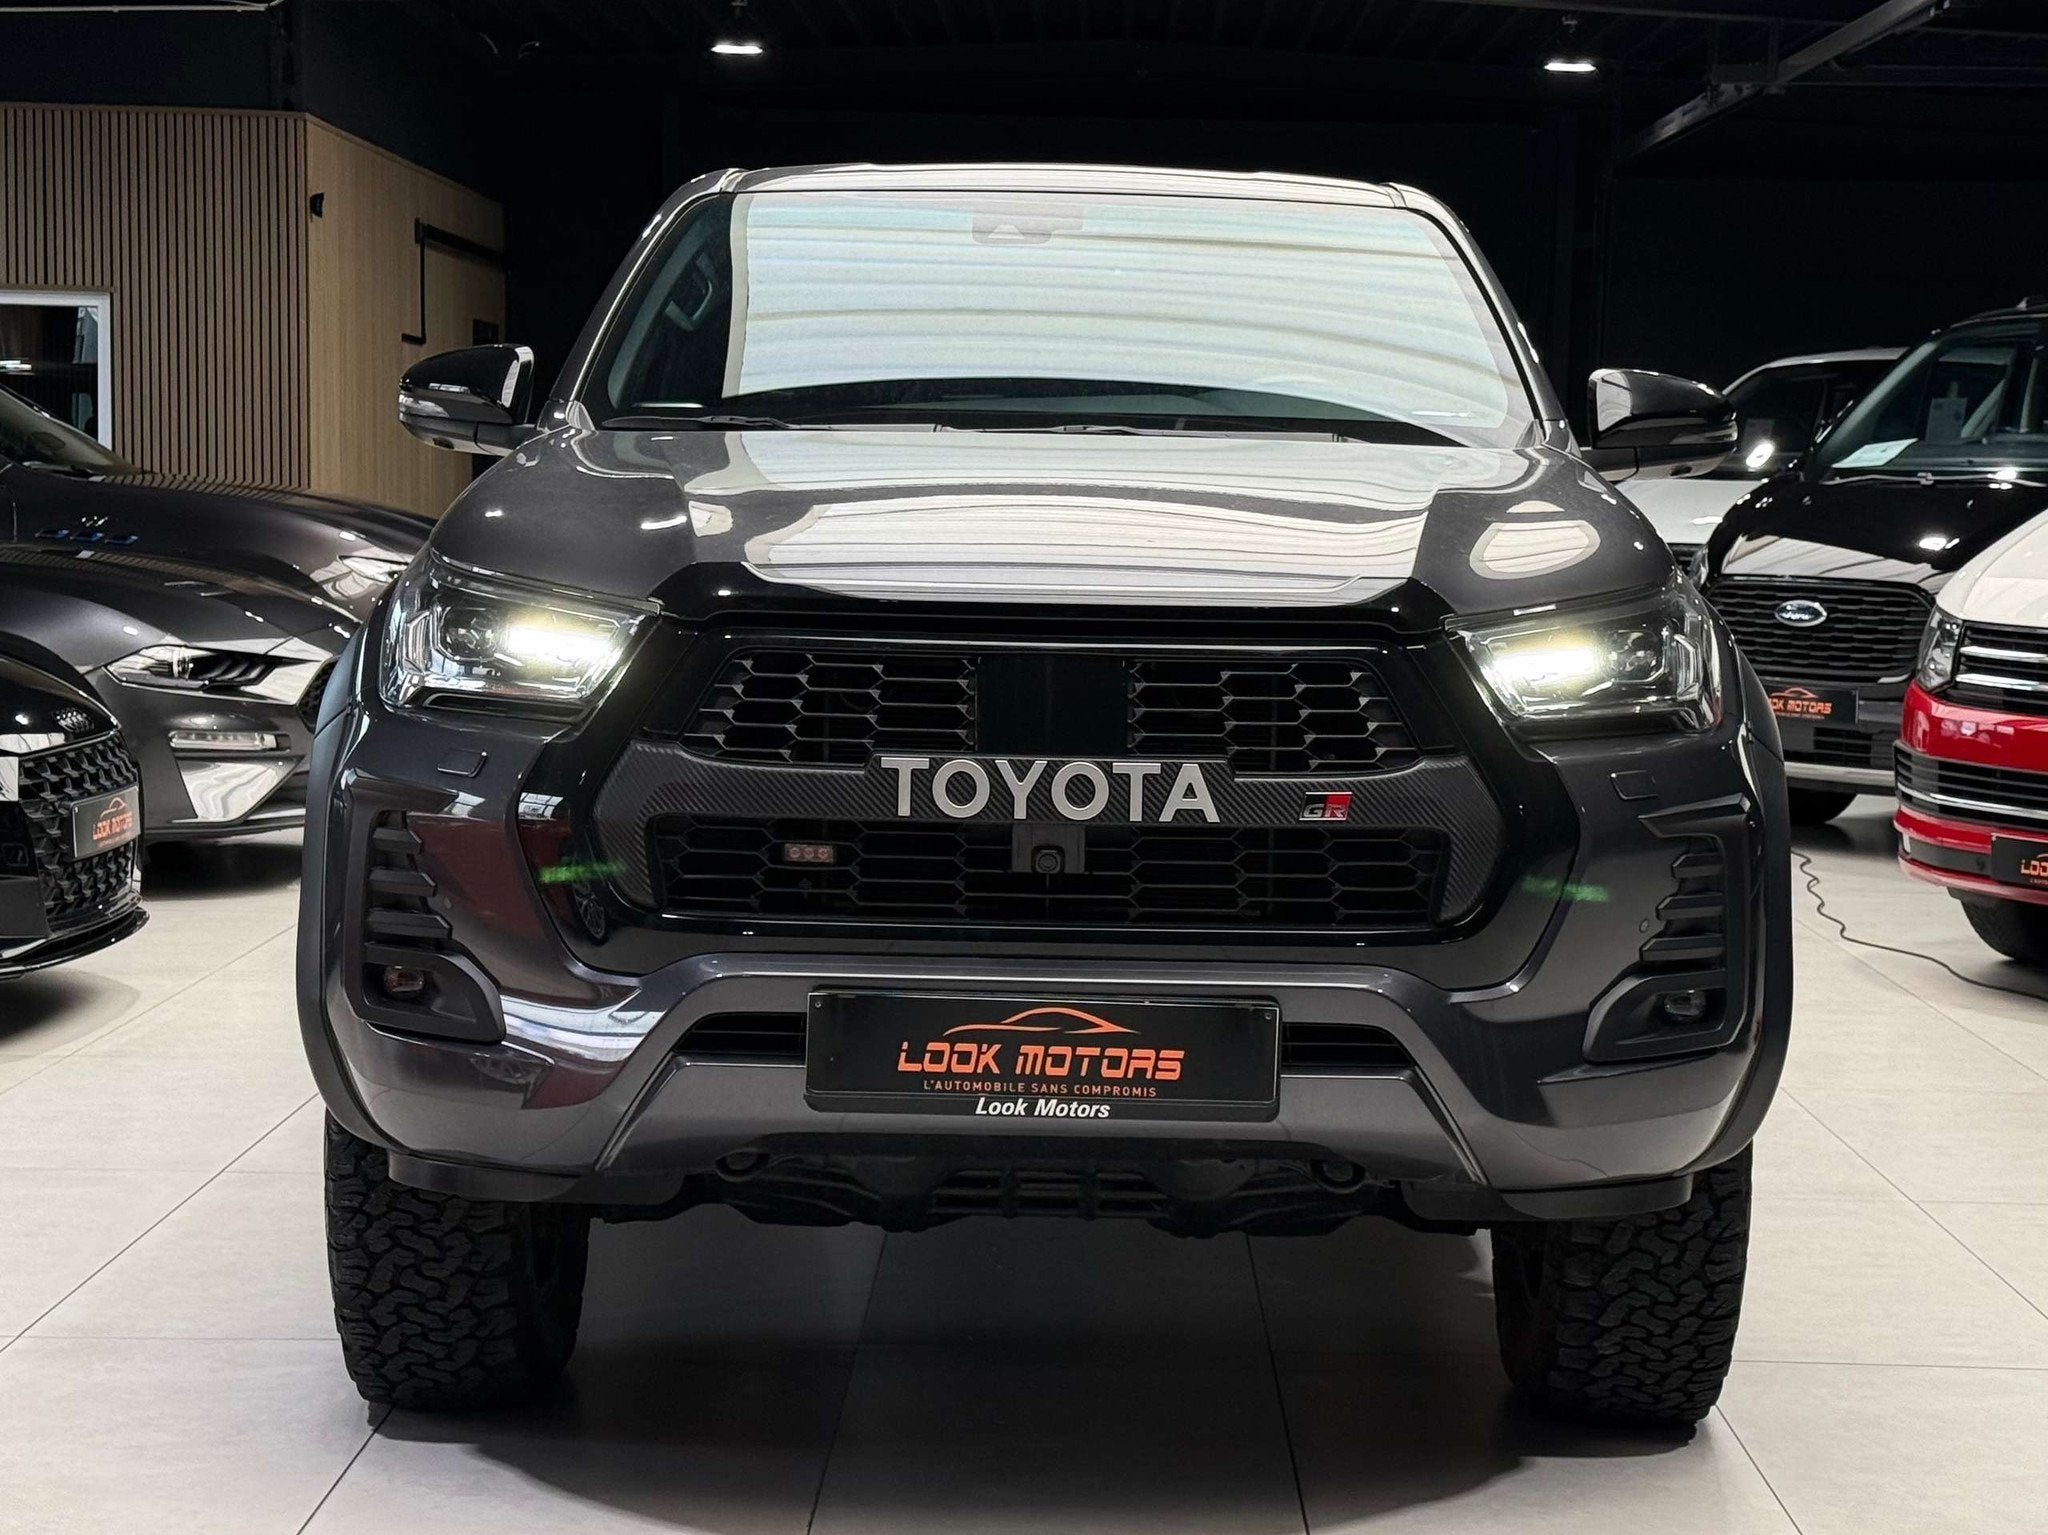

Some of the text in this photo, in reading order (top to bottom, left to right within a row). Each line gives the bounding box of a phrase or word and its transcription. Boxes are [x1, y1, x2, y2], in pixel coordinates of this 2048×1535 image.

[1786, 699, 1833, 715] MOTORS
[880, 756, 1221, 823] TOYOTA
[1303, 803, 1347, 818] GR
[898, 1041, 1185, 1081] LOOK MOTORS
[924, 1080, 1158, 1098] L'AUTOMOBILE SANS COMPROMIS
[975, 1096, 1112, 1118] Look Motors
